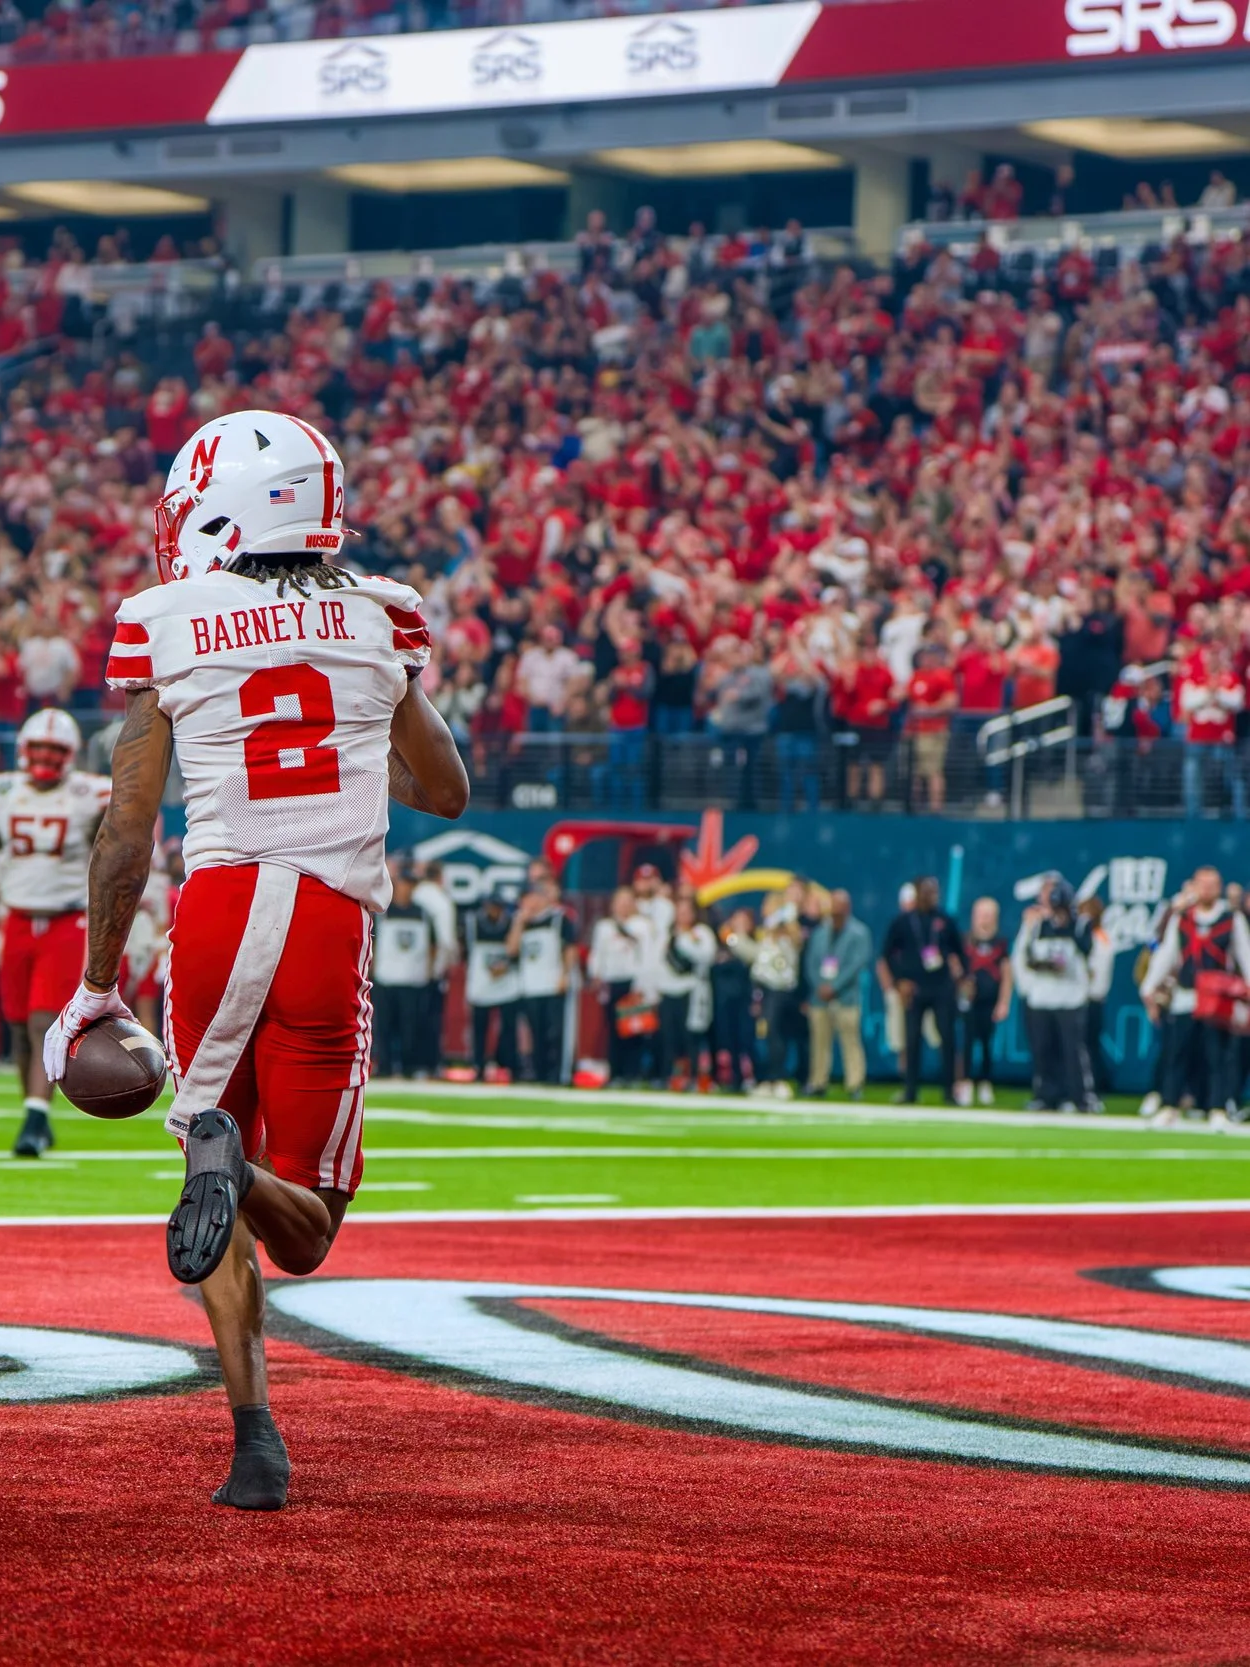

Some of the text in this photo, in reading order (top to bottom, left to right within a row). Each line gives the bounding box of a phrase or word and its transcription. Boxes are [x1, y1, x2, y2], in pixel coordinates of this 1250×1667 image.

[1065, 0, 1237, 56] SRS
[318, 62, 390, 97] SRS
[471, 48, 543, 86] SRS
[189, 435, 222, 482] N
[334, 486, 344, 519] 2
[190, 600, 356, 656] BARNEY JR.
[238, 662, 341, 801] 2
[10, 815, 69, 859] 57
